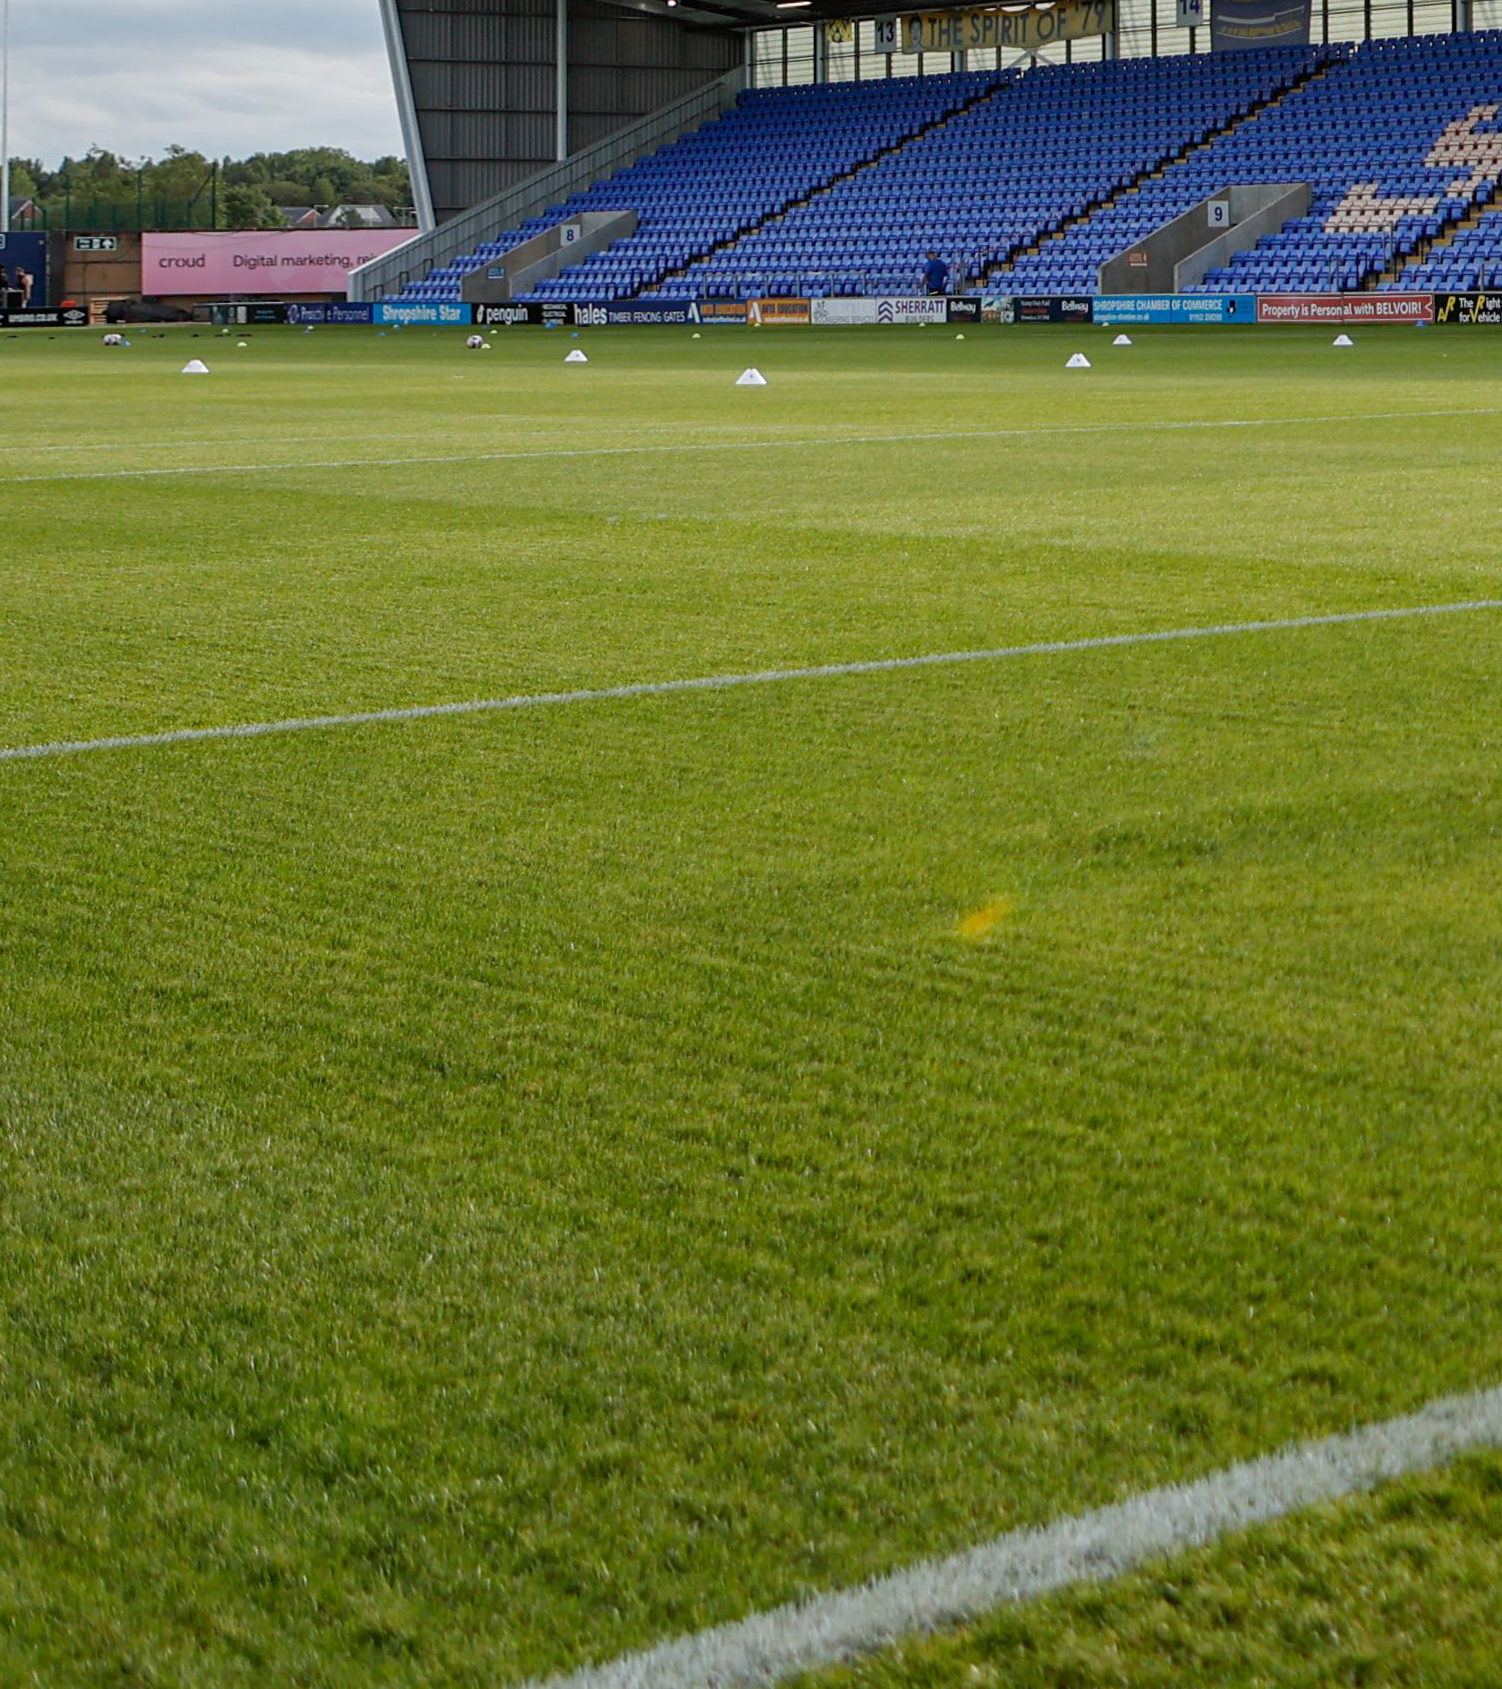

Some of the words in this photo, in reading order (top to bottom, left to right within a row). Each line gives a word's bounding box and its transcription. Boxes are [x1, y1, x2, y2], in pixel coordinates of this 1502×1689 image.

[929, 16, 963, 47] THE
[970, 12, 1030, 46] SPIRIT
[1037, 8, 1067, 40] OF
[1075, 0, 1106, 31] '79
[877, 23, 895, 43] 13
[1214, 206, 1223, 221] 9
[566, 229, 574, 241] 8
[159, 254, 205, 268] croud
[233, 255, 277, 270] Digital
[281, 255, 354, 270] marketing,
[895, 301, 945, 314] SHERRATT
[951, 301, 976, 314] Bellway
[1062, 300, 1089, 313] Bellway
[1093, 299, 1135, 311] SHROPSHIRE
[1136, 299, 1170, 311] CHAMBER
[1172, 299, 1181, 310] OF
[1182, 299, 1222, 310] COMMERCE
[1262, 303, 1300, 318] Property
[1301, 303, 1309, 315] is
[1311, 303, 1352, 316] Personal
[1353, 302, 1375, 315] with
[1376, 302, 1422, 315] BELVOIR!
[1459, 297, 1473, 308] The
[1476, 295, 1500, 310] Right
[383, 304, 436, 324] Shropshire
[439, 304, 461, 320] Star
[486, 304, 528, 325] penguin
[574, 303, 607, 324] hales
[609, 312, 631, 323] TIMBER
[634, 312, 661, 323] FENCING
[664, 311, 686, 322] GATES
[906, 314, 935, 323] BUILDERS
[1459, 312, 1470, 322] for
[1469, 309, 1500, 323] Vehicle
